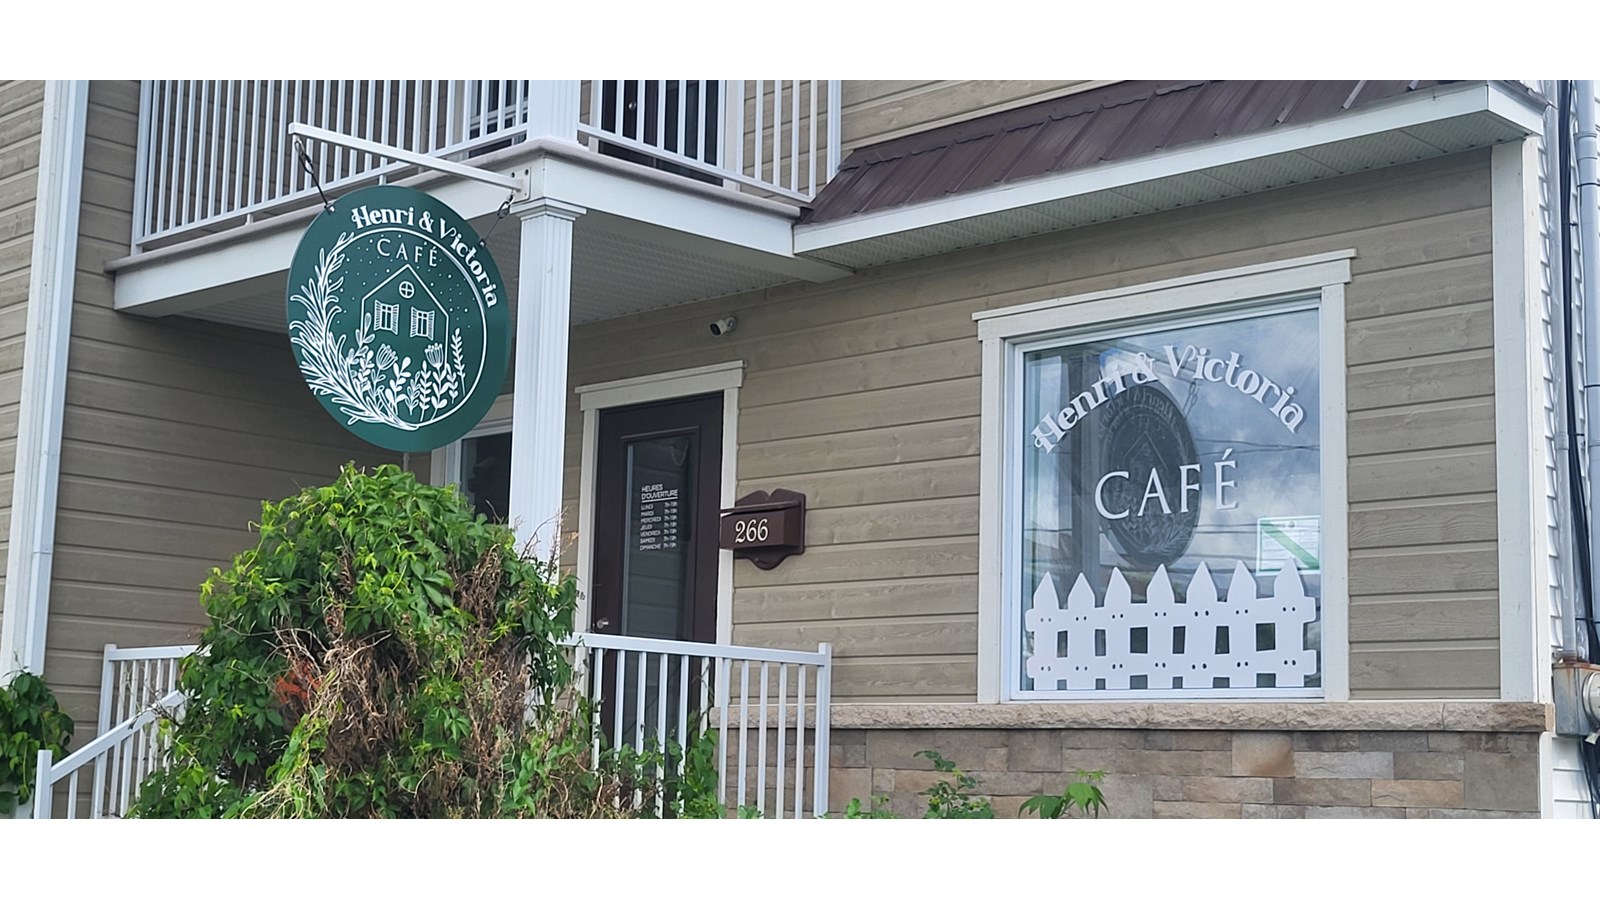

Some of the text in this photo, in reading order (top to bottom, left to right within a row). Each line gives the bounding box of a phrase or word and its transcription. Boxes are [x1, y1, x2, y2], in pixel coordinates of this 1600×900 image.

[351, 205, 498, 308] Henri & Victoria
[376, 238, 437, 267] CAFÉ
[1031, 363, 1126, 454] Henri
[1131, 352, 1159, 383] &
[1162, 344, 1305, 434] Victoria
[641, 484, 663, 492] HEURES
[1095, 448, 1238, 520] CAFÉ
[734, 518, 768, 543] 266
